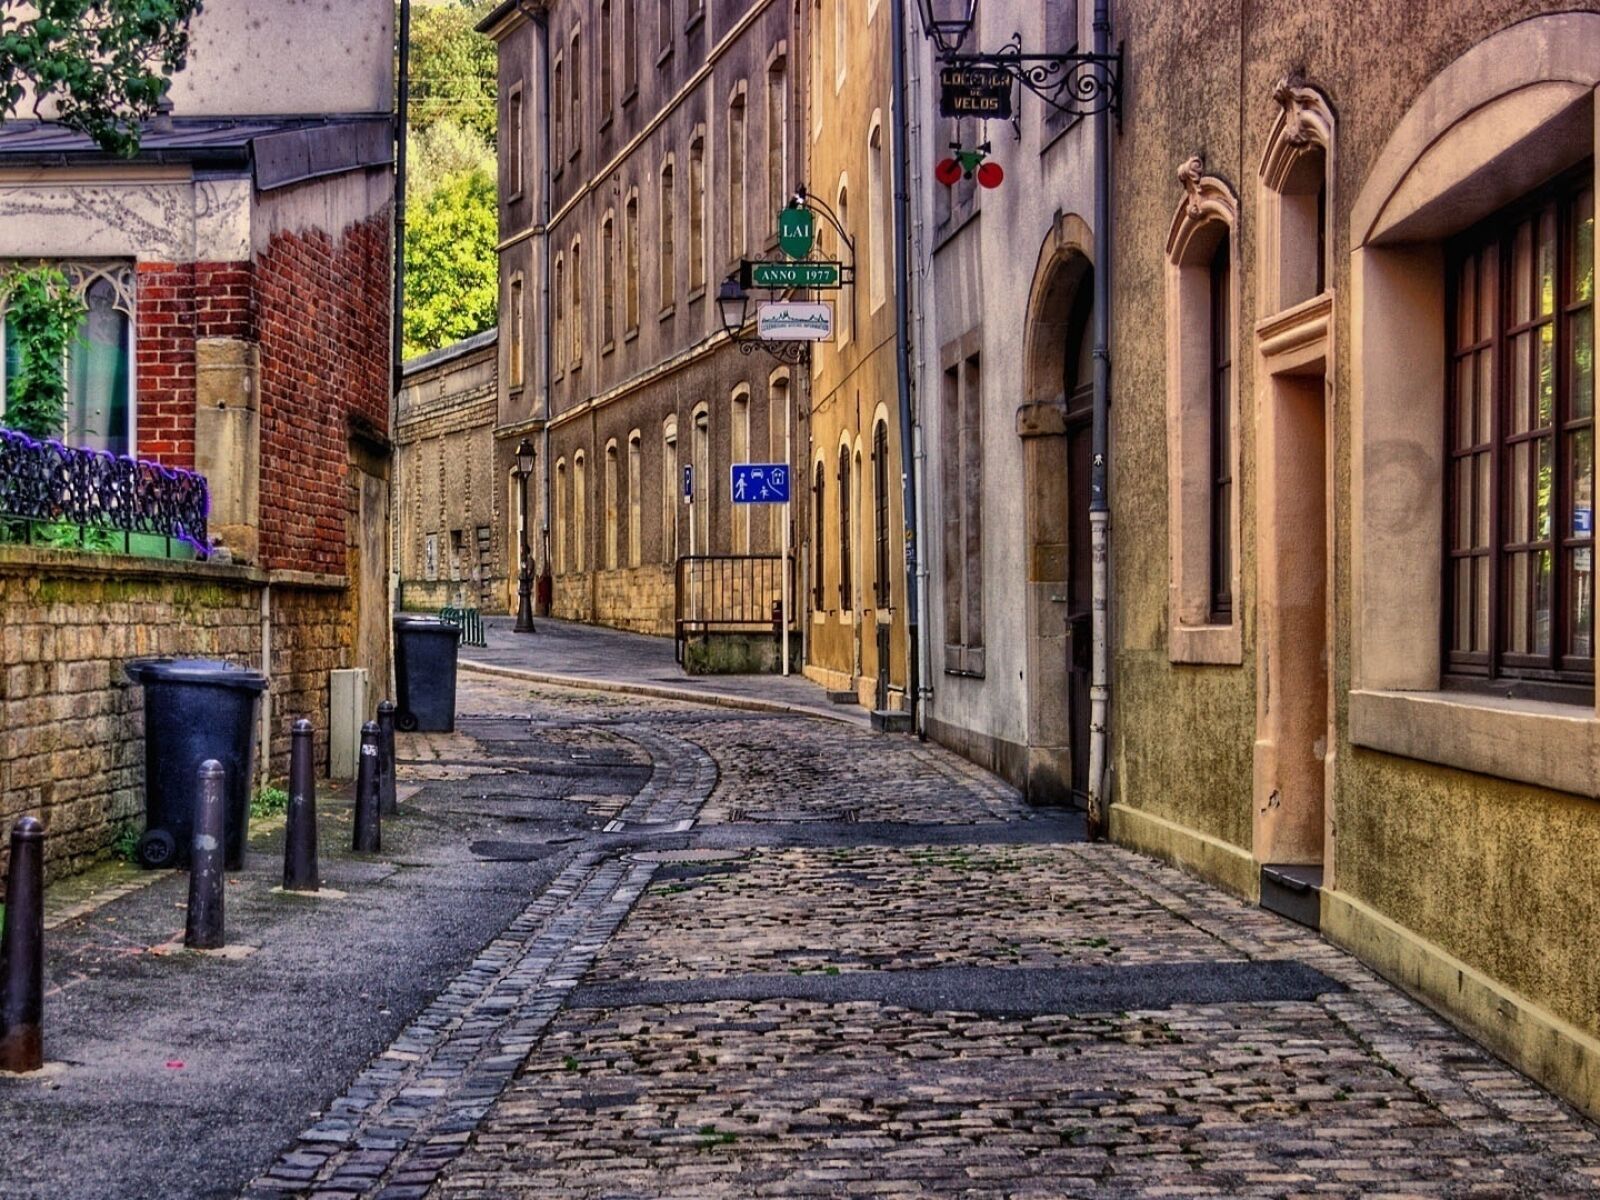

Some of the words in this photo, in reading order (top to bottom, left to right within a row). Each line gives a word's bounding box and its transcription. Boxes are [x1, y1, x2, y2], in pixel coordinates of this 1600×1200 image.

[943, 72, 1010, 86] LOCTON
[954, 97, 999, 110] VELOS
[783, 225, 809, 238] LAI
[762, 270, 796, 280] ANNO
[806, 270, 830, 280] 1977
